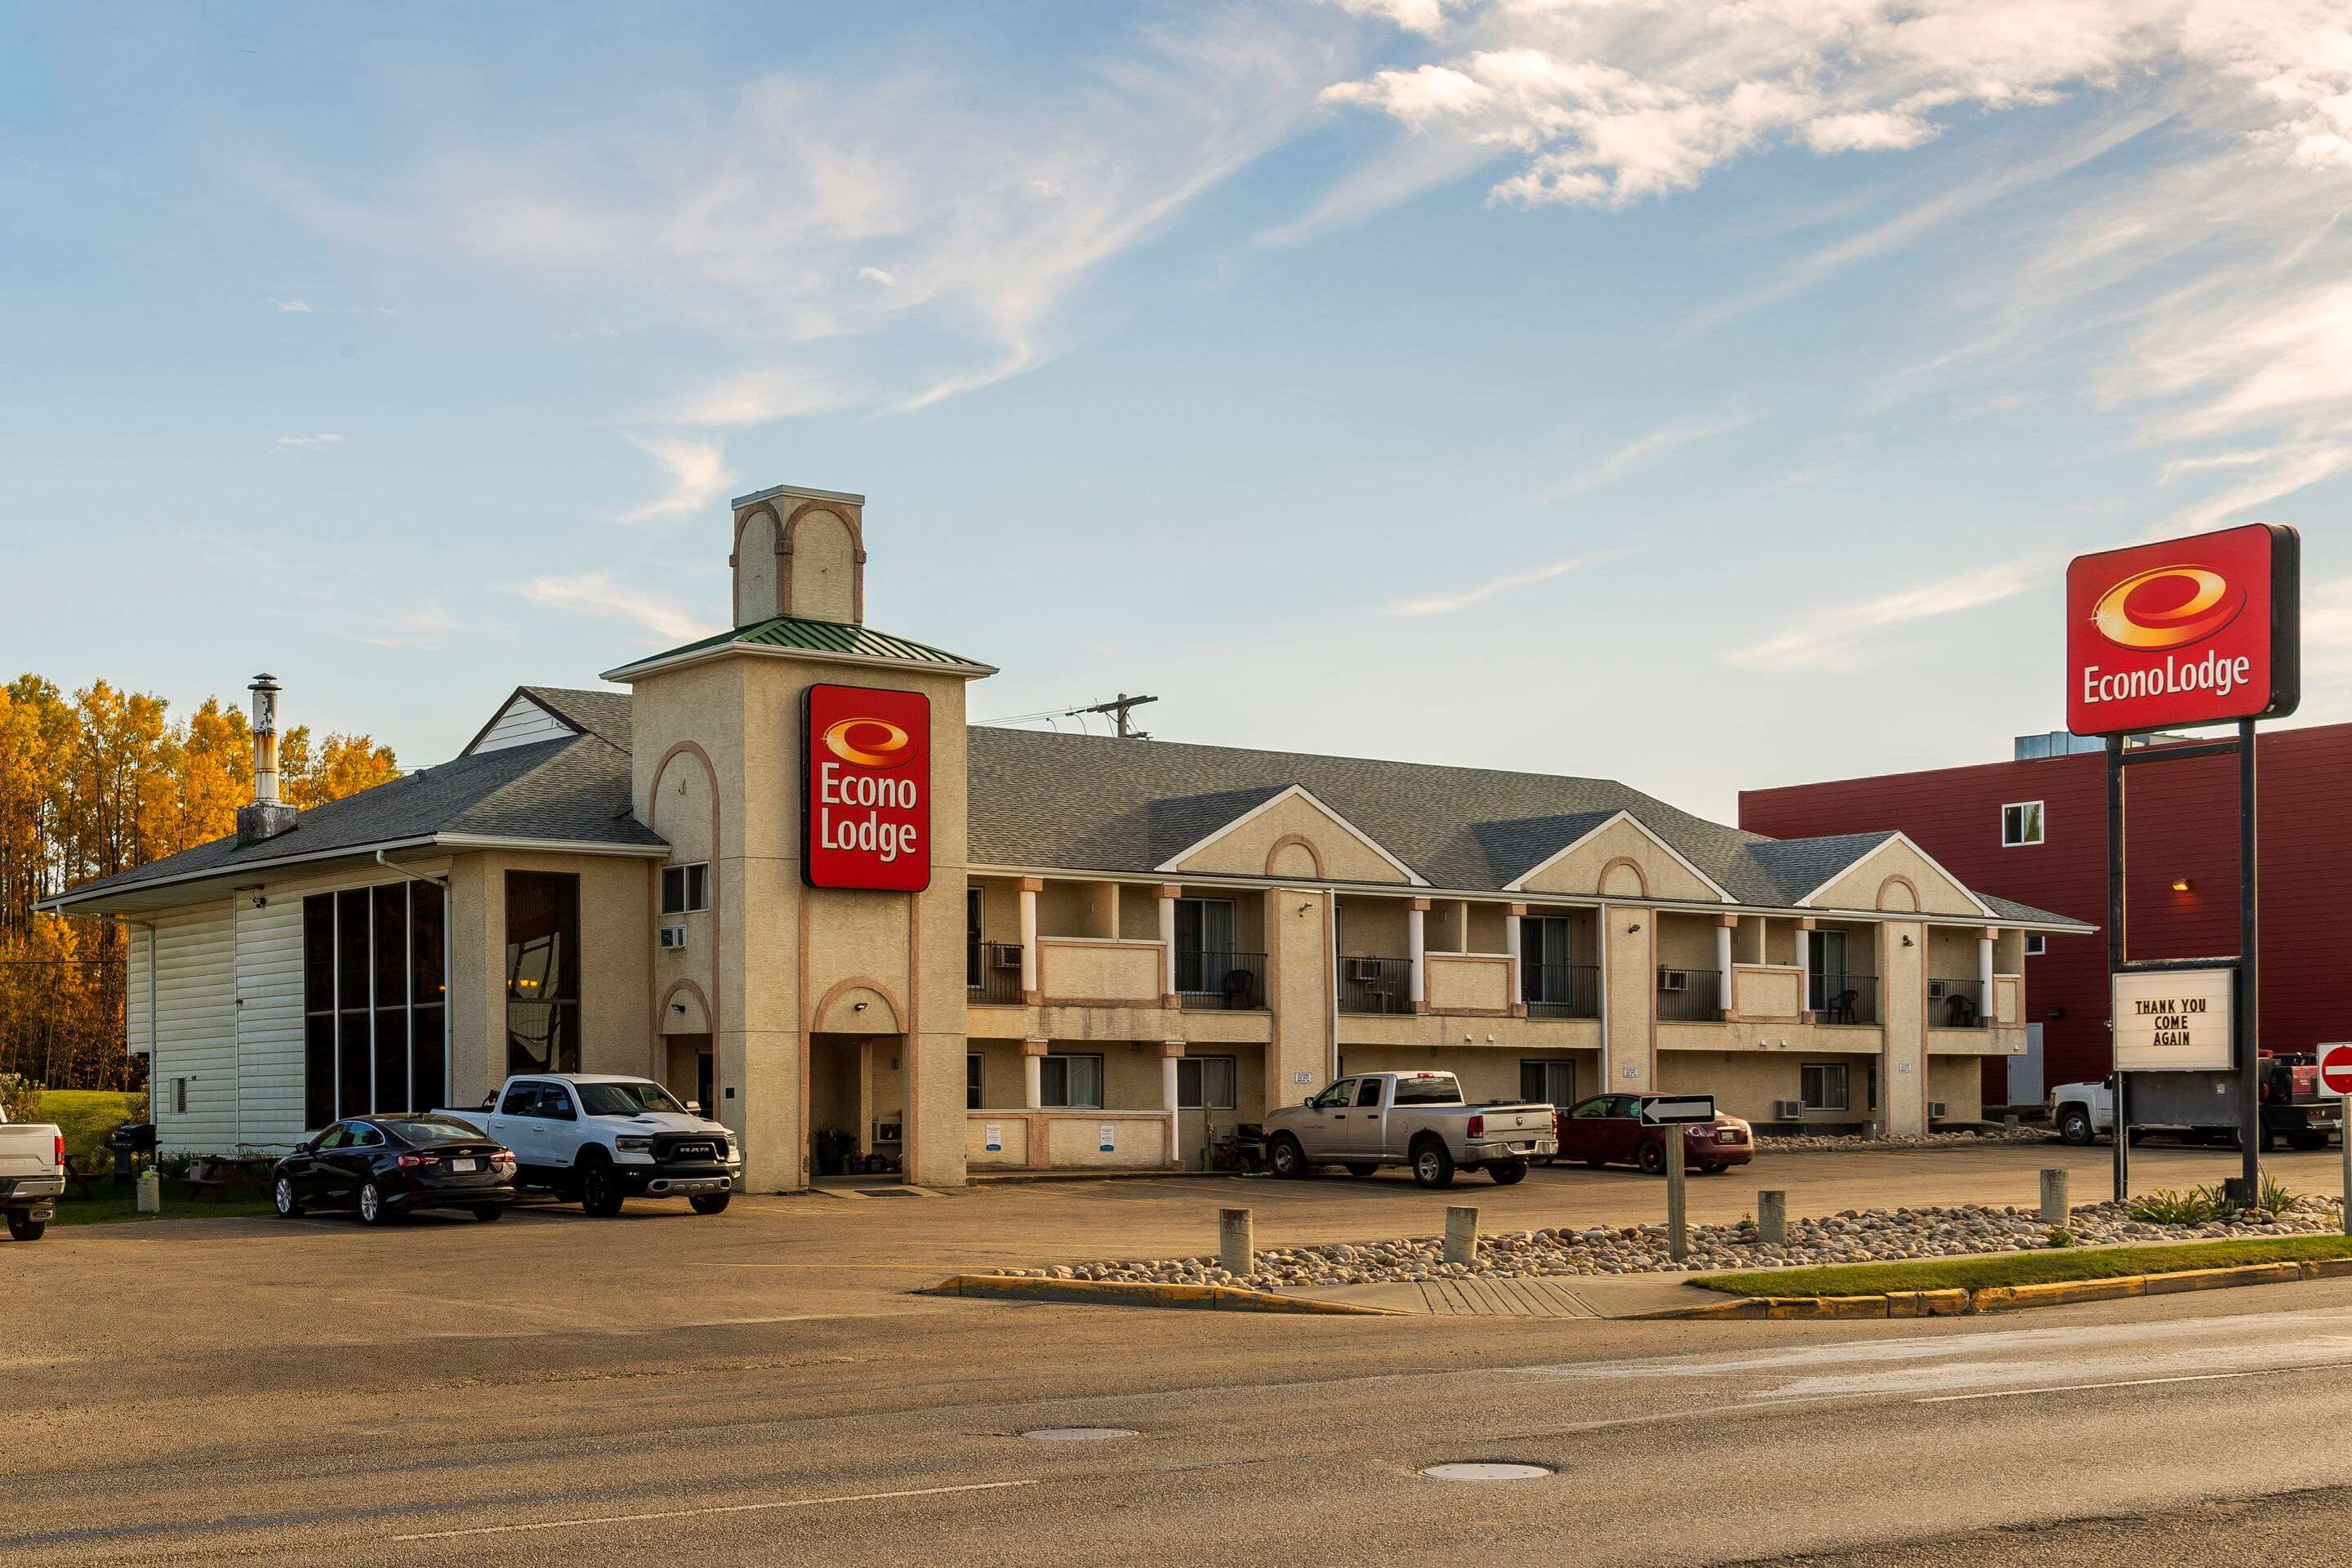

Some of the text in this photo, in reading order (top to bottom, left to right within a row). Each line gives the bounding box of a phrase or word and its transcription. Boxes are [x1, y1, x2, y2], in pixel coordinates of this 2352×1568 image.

[822, 762, 916, 809] Econo
[822, 808, 916, 862] Lodge
[2136, 999, 2207, 1014] THANK YOU
[2154, 1016, 2188, 1030] COME
[2154, 1031, 2190, 1045] AGAIN
